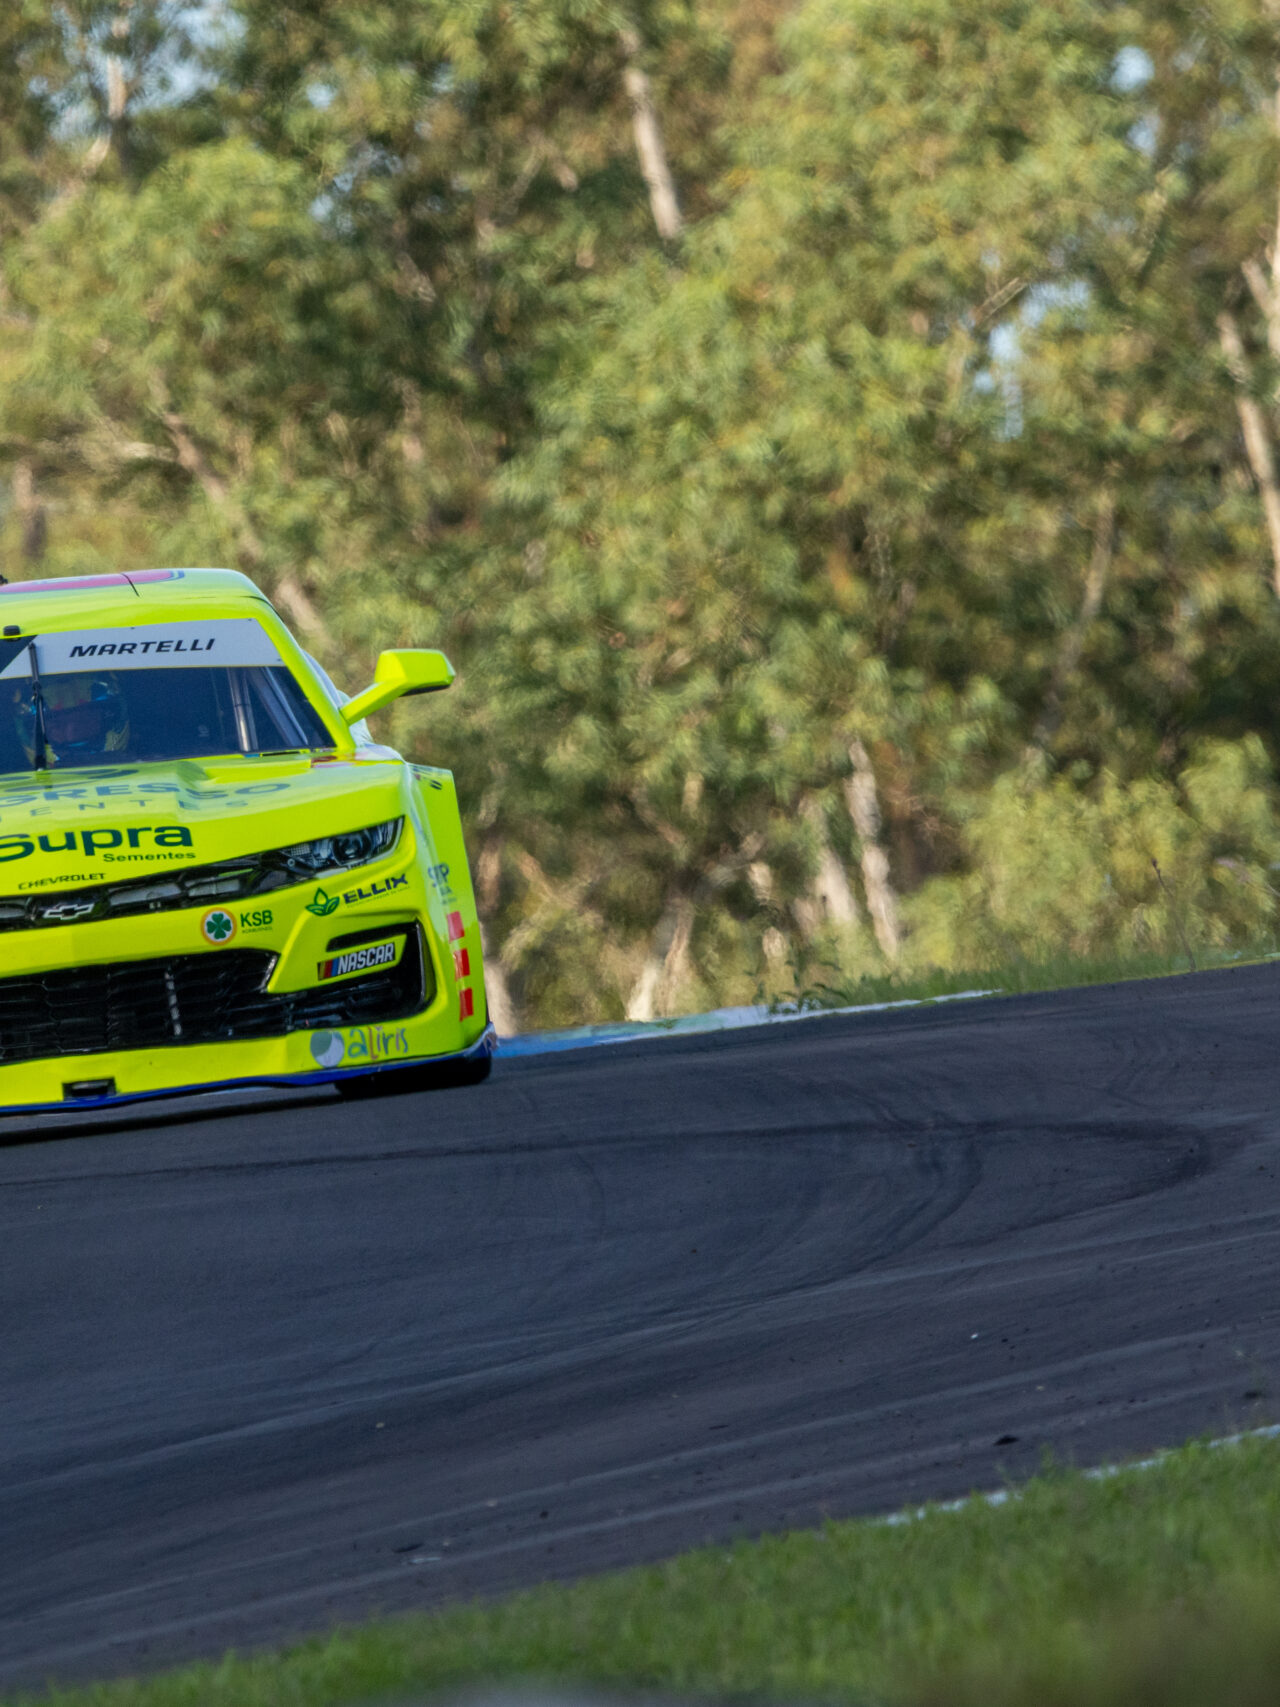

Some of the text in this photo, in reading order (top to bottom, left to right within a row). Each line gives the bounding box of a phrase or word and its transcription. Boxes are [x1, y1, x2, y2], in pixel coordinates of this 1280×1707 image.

[69, 638, 215, 658] MARTELLI
[103, 851, 196, 863] Sementes
[18, 873, 106, 891] CHEVROLET
[343, 873, 409, 905] ELLIX
[240, 909, 273, 928] KSB
[337, 943, 394, 976] NASCAR
